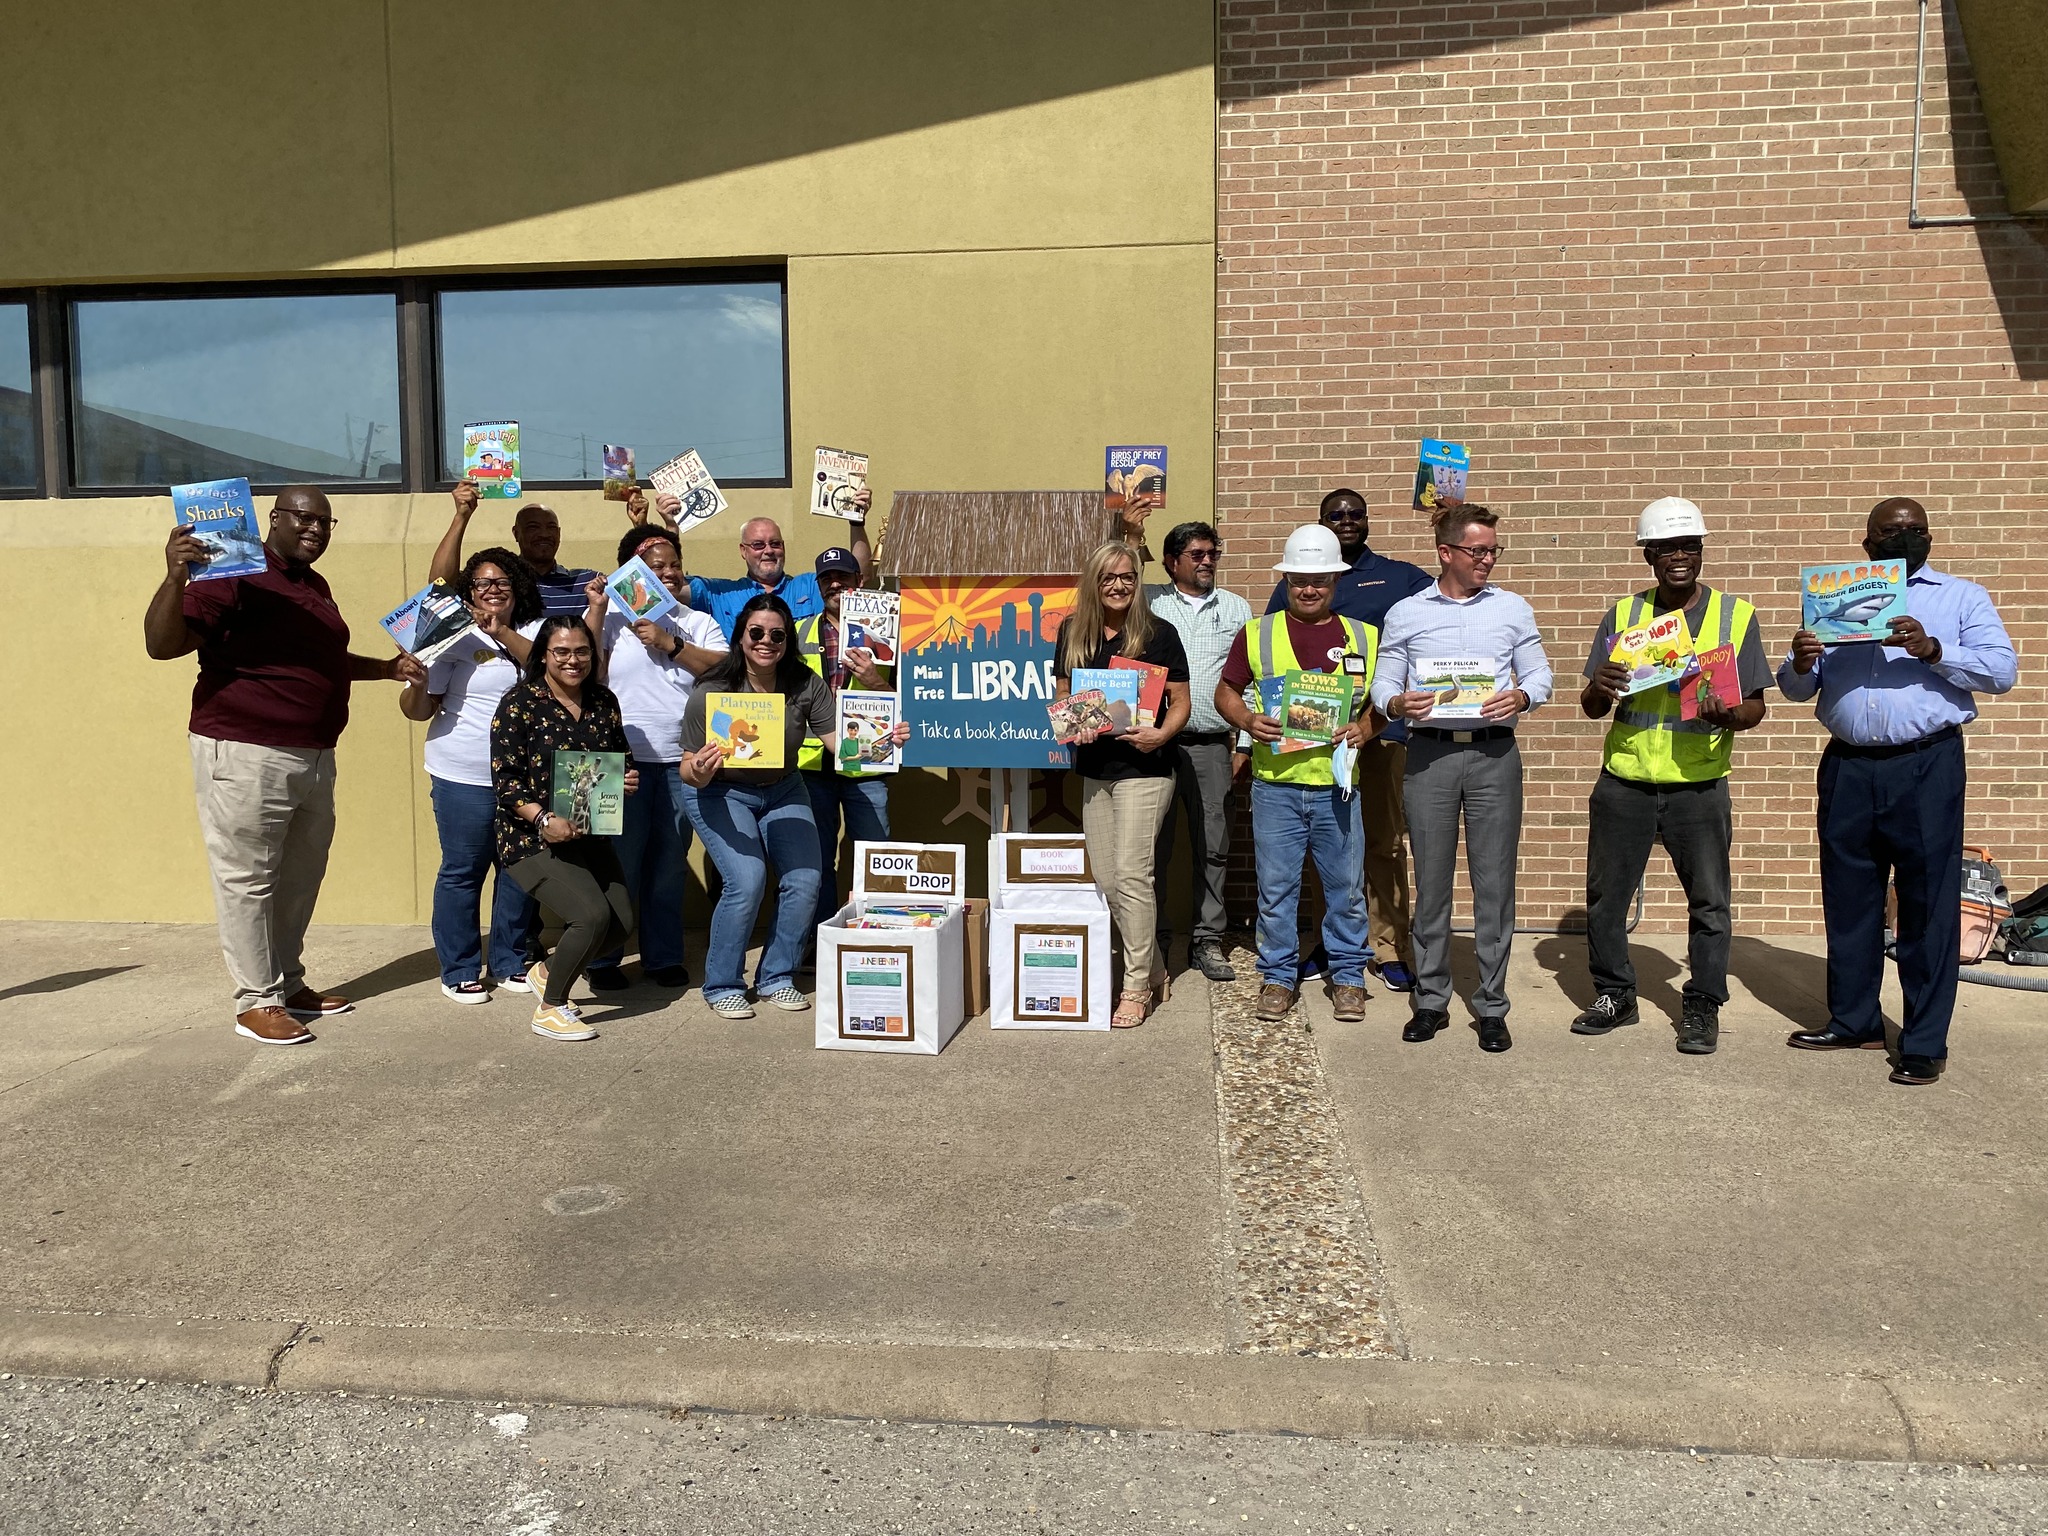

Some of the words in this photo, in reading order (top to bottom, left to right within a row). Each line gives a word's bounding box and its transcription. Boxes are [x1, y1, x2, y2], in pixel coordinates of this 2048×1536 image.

[498, 429, 516, 446] Trip
[818, 455, 866, 472] INVENTION
[1110, 459, 1137, 468] RESCUE
[1111, 451, 1132, 460] BIRDS
[1133, 451, 1142, 460] OF
[1143, 451, 1162, 460] PREY
[654, 457, 702, 491] BATTLE!
[208, 487, 240, 499] facts
[185, 501, 245, 523] Sharks
[1807, 564, 1900, 594] SHARKS
[1818, 590, 1846, 600] BIGGER
[1848, 581, 1889, 594] BIGGEST
[385, 616, 395, 627] All
[395, 599, 418, 620] Aboard
[845, 597, 888, 614] TEXAS
[391, 613, 416, 634] ABC
[1648, 619, 1678, 640] HOP!
[1701, 648, 1732, 668] DUROY
[913, 664, 943, 680] Mini
[1083, 671, 1094, 679] My
[1096, 671, 1130, 680] Precious
[1300, 673, 1338, 687] COWS
[951, 660, 1057, 701] LIBRAR
[1080, 679, 1107, 688] Little
[1109, 680, 1133, 689] Bear
[1302, 683, 1316, 691] THE
[1316, 685, 1345, 694] PARLOR
[914, 686, 945, 700] Free
[720, 696, 773, 710] Platypus
[845, 700, 892, 713] Electricity
[1048, 700, 1068, 715] BABY
[1068, 690, 1103, 706] GIRAFFE
[954, 727, 962, 739] a
[1000, 721, 1041, 740] Share
[1042, 728, 1050, 740] a
[599, 792, 619, 800] Secrets
[872, 857, 914, 870] BOOK
[1030, 864, 1078, 872] DONATIONS
[909, 875, 950, 888] DROP
